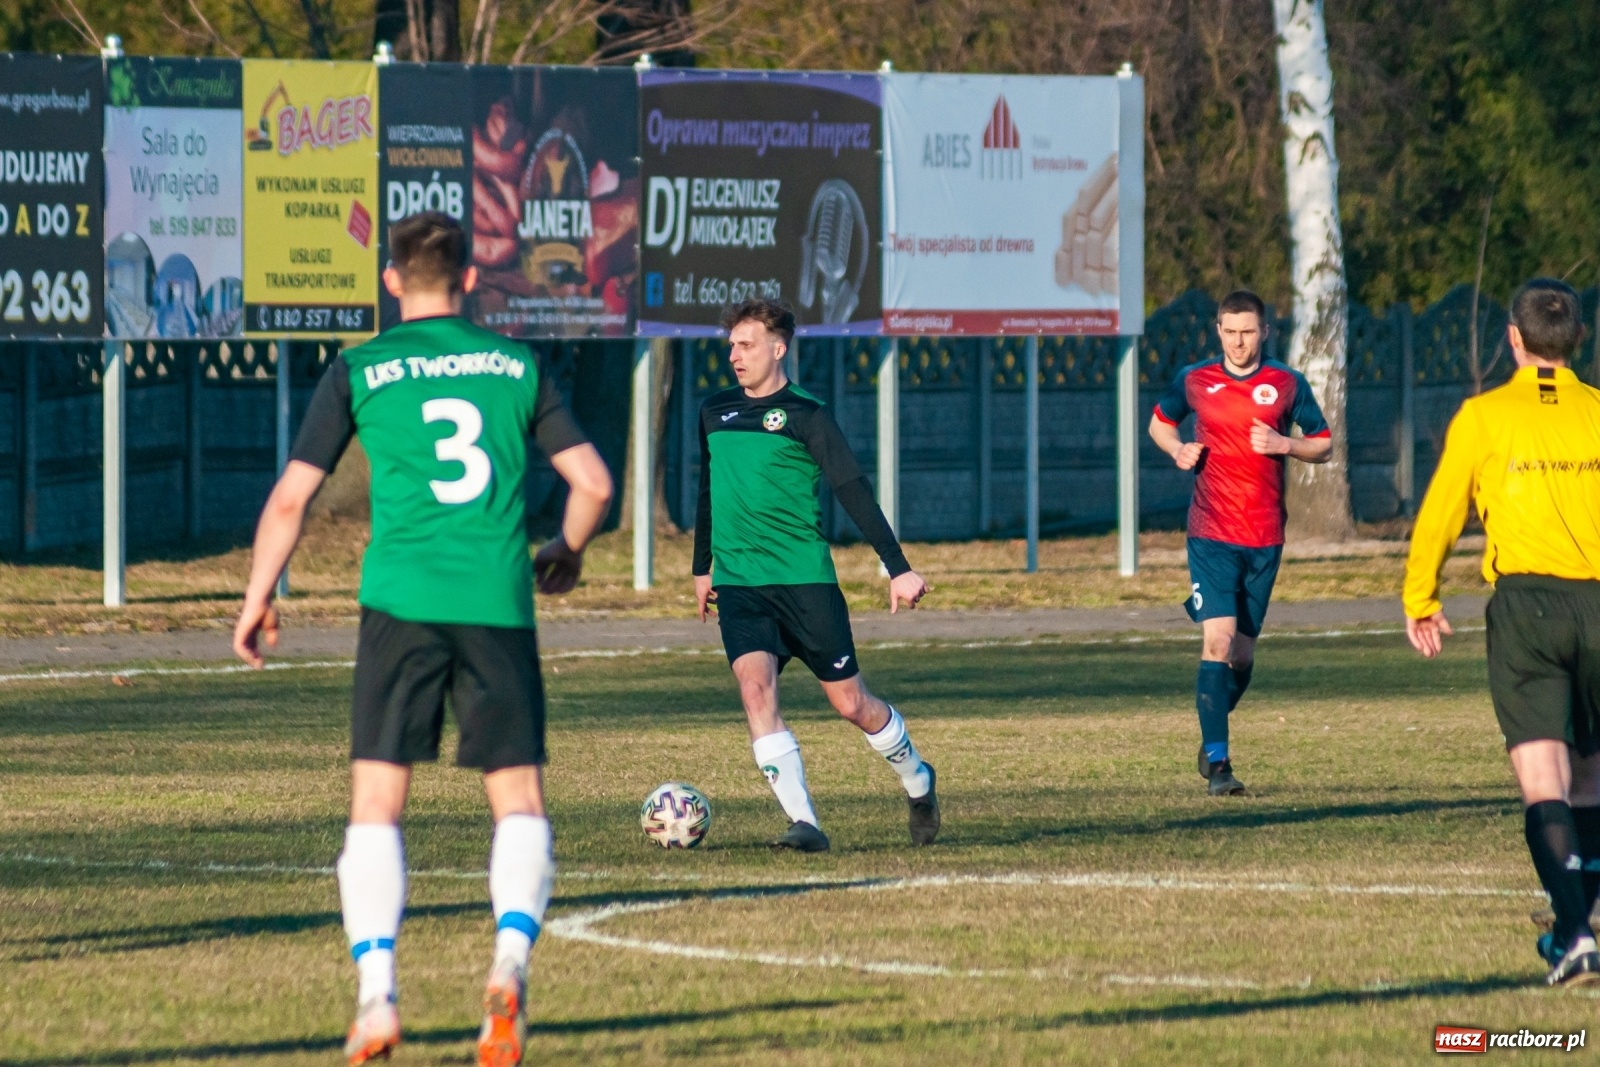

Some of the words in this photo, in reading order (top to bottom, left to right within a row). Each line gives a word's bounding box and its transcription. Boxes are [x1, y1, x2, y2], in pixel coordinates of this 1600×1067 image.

[141, 126, 178, 156] Sala
[183, 129, 207, 156] do
[277, 94, 374, 157] BAGER
[387, 124, 464, 143] WIEPRZOWINA
[646, 108, 720, 154] Oprawa
[721, 120, 809, 156] muzyczna
[811, 110, 872, 157] imprez
[0, 150, 90, 184] DUJEMY
[387, 147, 464, 168] WOŁOWINA
[923, 133, 972, 169] ABIES
[129, 166, 220, 201] Wynajęcia
[256, 176, 317, 193] WYKONAM
[320, 177, 365, 194] USŁUGI
[387, 170, 464, 222] DRÓB
[690, 178, 781, 209] EUGENIUSZ
[15, 203, 32, 236] A
[37, 203, 70, 236] DO
[75, 203, 90, 236] Z
[284, 202, 341, 223] KOPARKĄ
[518, 200, 593, 238] JANETA
[645, 176, 689, 256] DJ
[688, 215, 776, 249] MIKOŁAJEK
[918, 234, 976, 257] specjalista
[979, 235, 993, 252] od
[996, 235, 1034, 252] drewna
[289, 248, 332, 265] USŁUGI
[30, 270, 91, 323] 363
[265, 273, 356, 290] TRANSPORTOWE
[674, 273, 696, 304] tel.
[699, 278, 728, 305] 660
[759, 278, 781, 300] 761
[273, 309, 301, 328] 880
[304, 309, 332, 328] 557
[364, 359, 406, 390] LKS
[405, 349, 526, 380] TWORKÓW
[421, 397, 493, 504] 3
